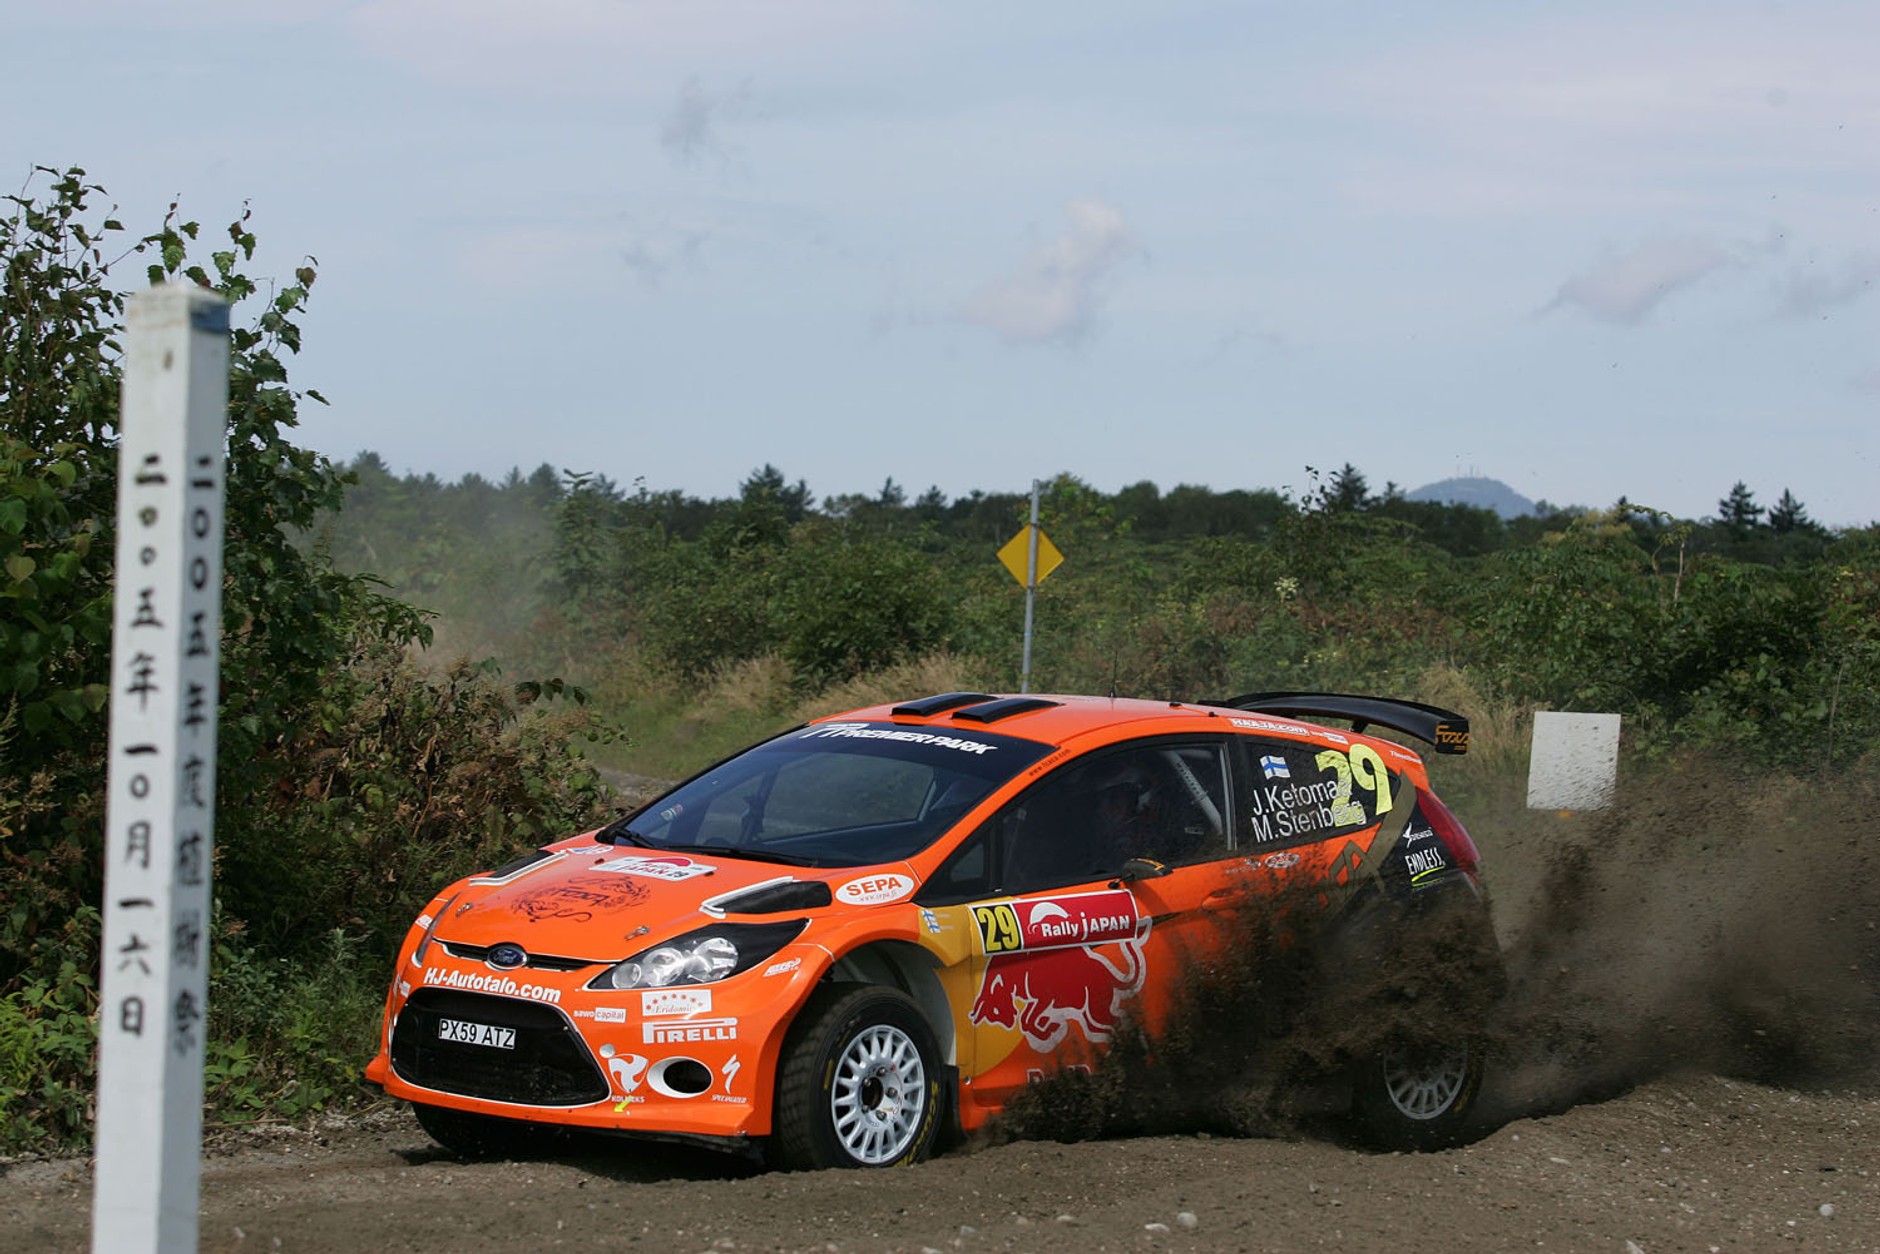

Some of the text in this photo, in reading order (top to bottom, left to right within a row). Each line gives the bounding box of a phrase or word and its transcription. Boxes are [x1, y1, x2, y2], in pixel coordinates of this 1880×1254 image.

[116, 454, 168, 1038] 二〇〇五年一〇月一六日
[1253, 778, 1352, 816] J.Ketomaa
[1315, 743, 1393, 827] 29
[1251, 800, 1367, 843] M.Stenberg
[846, 876, 902, 896] SEPA
[976, 905, 1020, 951] 29
[1041, 922, 1079, 937] Rally
[424, 967, 562, 1003] HJ-Autotalo.com
[596, 1008, 625, 1020] capital
[642, 1017, 739, 1044] PIRELLI
[439, 1019, 516, 1049] PX59 ATZ
